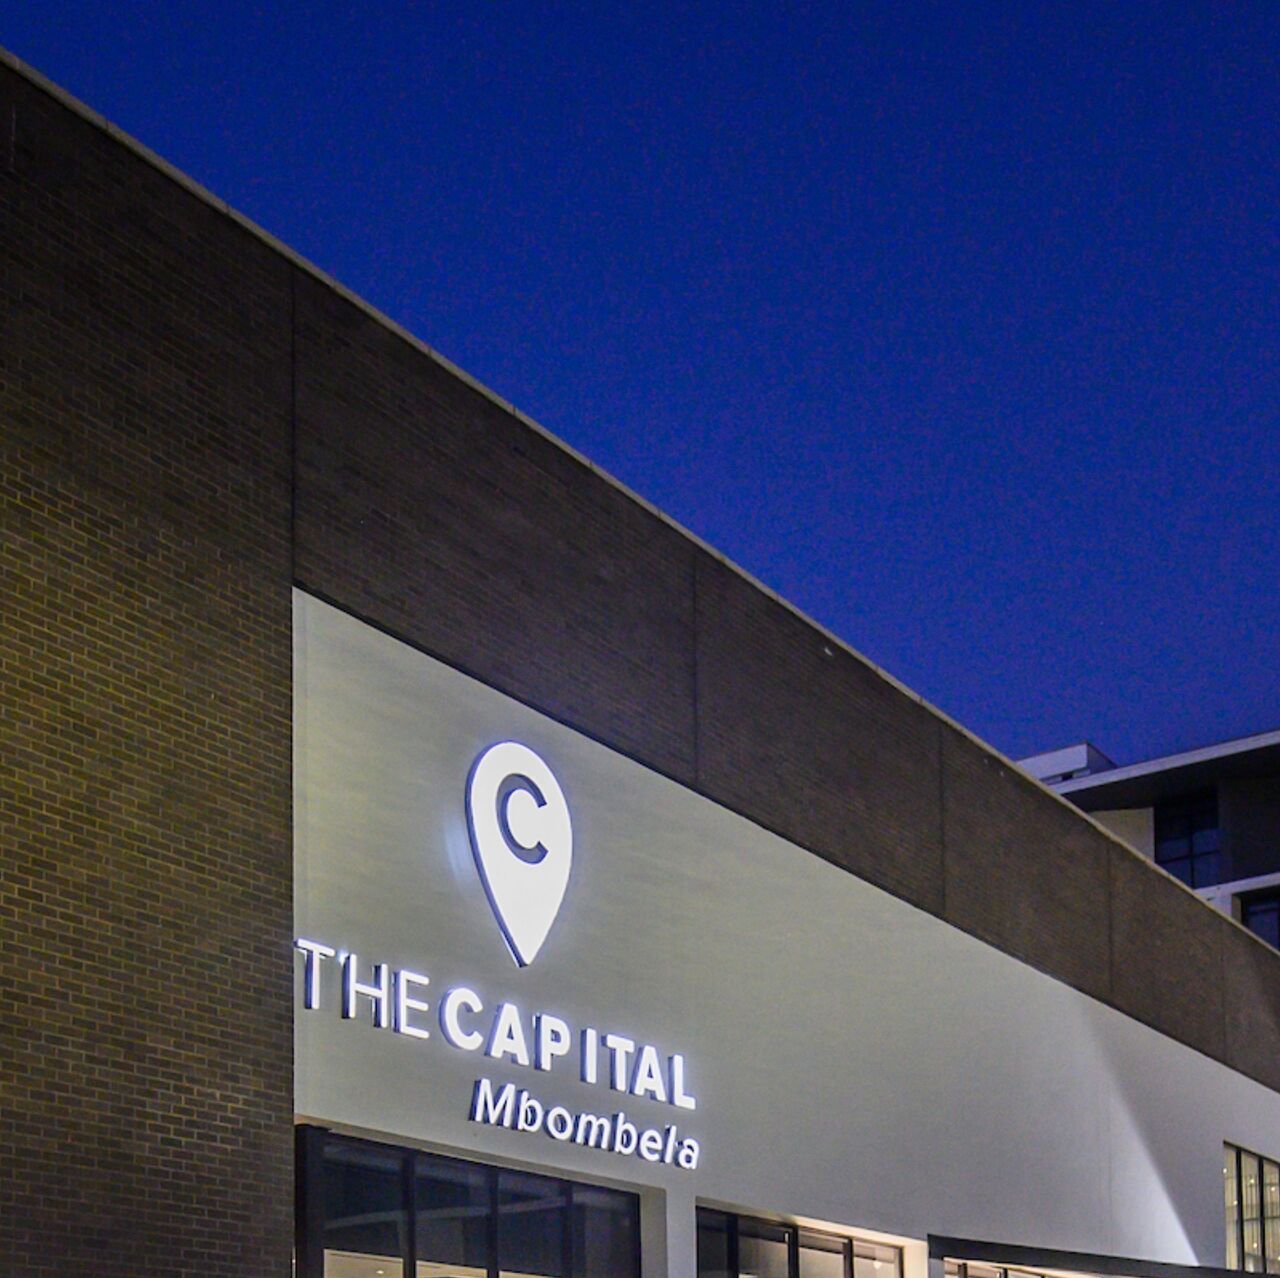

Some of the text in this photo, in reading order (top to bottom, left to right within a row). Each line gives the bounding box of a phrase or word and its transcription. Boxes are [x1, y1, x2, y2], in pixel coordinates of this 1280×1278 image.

[294, 937, 697, 1110] THE CAPITAL
[469, 1078, 701, 1170] Mbombela
